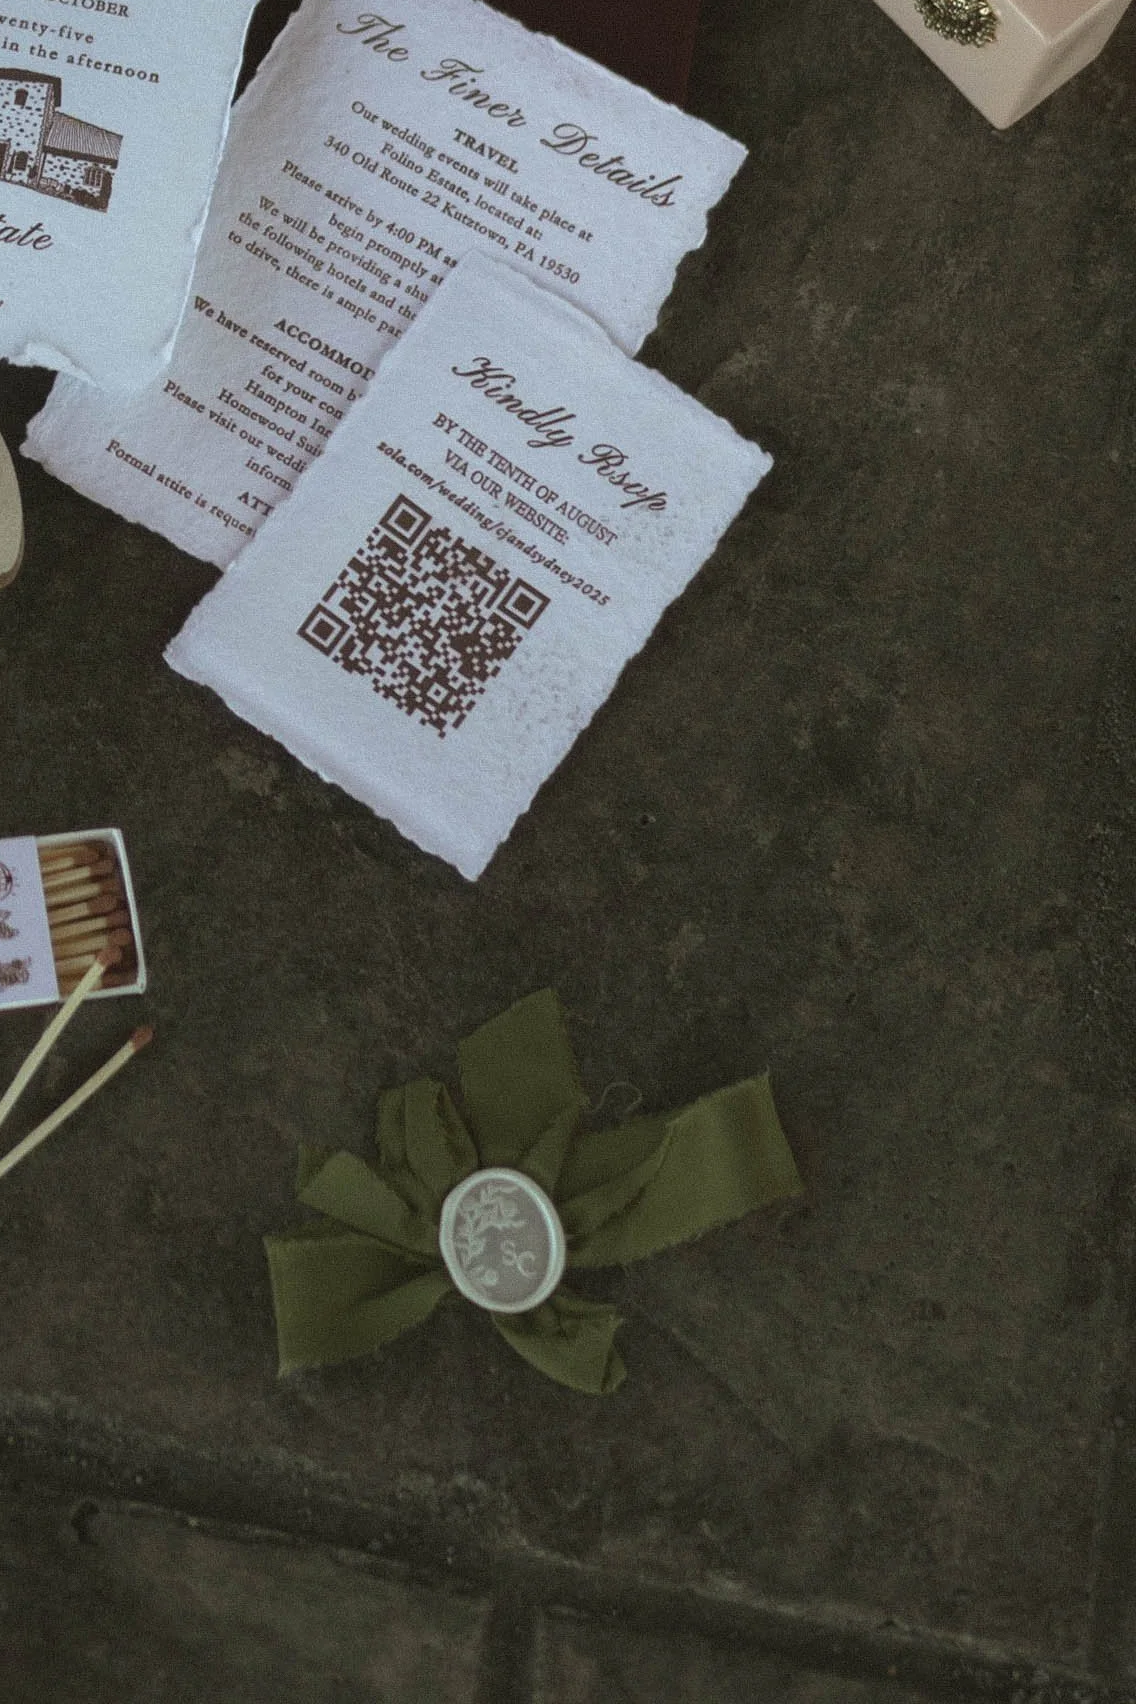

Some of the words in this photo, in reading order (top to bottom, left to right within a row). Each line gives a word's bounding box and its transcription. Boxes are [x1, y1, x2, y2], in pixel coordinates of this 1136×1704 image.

[1, 36, 19, 52] in
[29, 44, 58, 60] the
[66, 53, 159, 84] afternoon
[336, 13, 409, 62] The
[420, 58, 527, 127] Finer
[539, 123, 683, 208] Details
[453, 128, 519, 175] TRAVEL
[281, 159, 323, 192] Please
[324, 189, 364, 216] arrive
[365, 209, 384, 228] by
[385, 222, 415, 244] 4:00
[415, 237, 444, 260] PM
[323, 135, 350, 157] 340
[352, 152, 380, 174] Old
[379, 166, 420, 197] Route
[421, 190, 441, 208] 22
[440, 201, 509, 250] Kutztown,
[513, 241, 534, 262] PA
[539, 255, 580, 284] 19530
[351, 101, 379, 124] Our
[382, 119, 437, 159] wedding
[437, 152, 480, 181] events
[484, 176, 510, 196] will
[510, 191, 538, 213] take
[538, 208, 576, 233] place
[578, 229, 593, 243] at
[380, 141, 424, 174] Folino
[425, 168, 470, 204] Estate,
[474, 194, 525, 230] located
[525, 226, 543, 241] at:
[228, 231, 242, 245] to
[245, 241, 281, 271] drive,
[285, 266, 320, 291] there
[321, 285, 334, 300] is
[336, 297, 377, 323] ample
[239, 212, 261, 231] the
[262, 225, 325, 272] following
[326, 262, 367, 293] hotels
[369, 290, 397, 309] and
[259, 195, 280, 217] We
[283, 213, 308, 234] will
[308, 225, 326, 244] be
[325, 241, 392, 284] providing
[393, 279, 402, 288] a
[328, 212, 364, 242] begin
[365, 238, 429, 277] promptly
[194, 295, 215, 318] We
[215, 310, 248, 338] have
[249, 334, 308, 373] reserved
[307, 369, 344, 395] room
[346, 388, 362, 401] b
[260, 365, 284, 385] for
[282, 380, 318, 404] your
[163, 379, 206, 414] Please
[209, 410, 237, 433] visit
[239, 429, 264, 449] our
[216, 387, 296, 442] Homewood
[244, 379, 307, 424] Hampton
[451, 357, 576, 449] Kindly
[578, 444, 668, 512] Rsvp
[105, 439, 157, 477] Formal
[156, 473, 193, 500] attire
[194, 493, 207, 508] is
[432, 412, 460, 435] BY
[456, 428, 489, 458] THE
[486, 449, 538, 492] TENTH
[535, 485, 559, 504] OF
[556, 501, 619, 546] AUGUST
[445, 448, 469, 477] VIA
[470, 470, 503, 500] OUR
[504, 491, 569, 546] WEBSITE:
